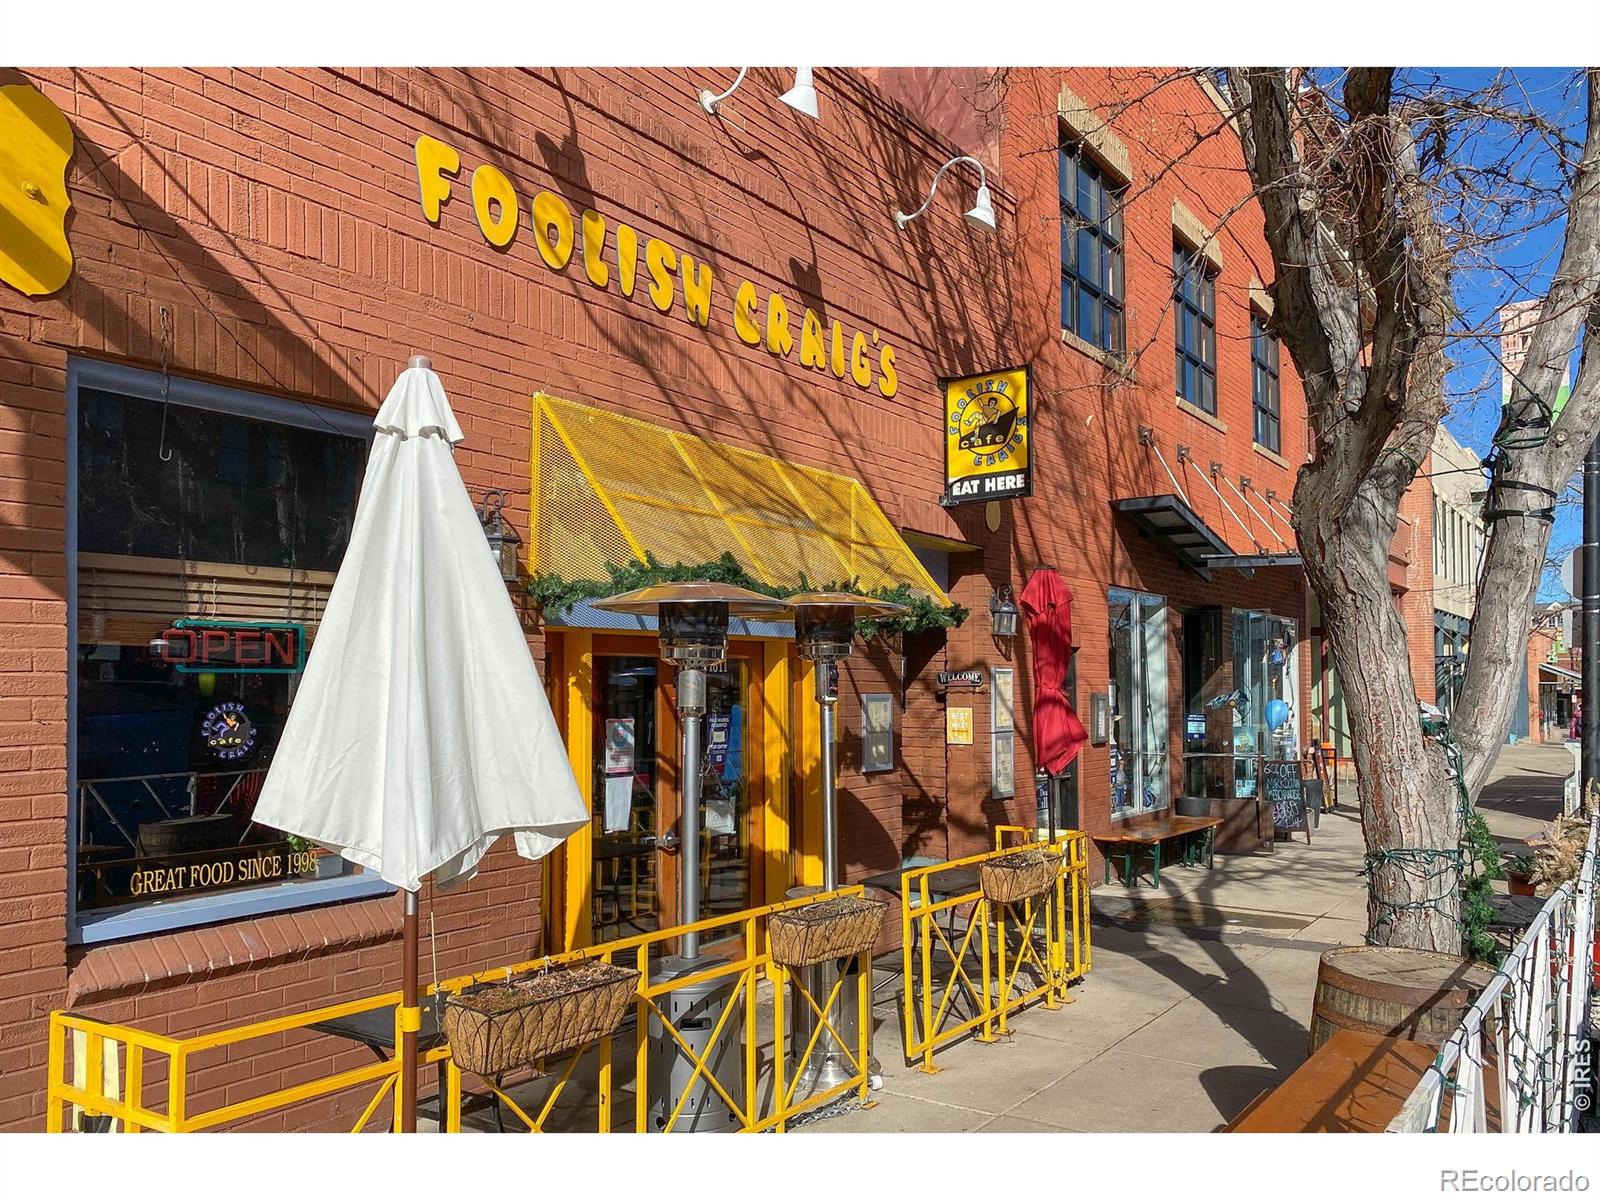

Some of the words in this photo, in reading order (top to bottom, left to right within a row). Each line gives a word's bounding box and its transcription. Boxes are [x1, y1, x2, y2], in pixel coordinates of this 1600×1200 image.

[414, 134, 713, 328] FOOLISH
[733, 280, 898, 398] CRAIG'S
[950, 379, 1008, 435] FOOLISH
[960, 434, 1004, 448] cafe
[952, 480, 980, 496] EAT
[984, 474, 1025, 492] HERE
[161, 628, 294, 665] OPEN
[940, 672, 981, 683] WELCOME
[209, 736, 242, 746] cafe
[1279, 763, 1298, 778] OFF
[130, 866, 187, 895] GREAT
[190, 861, 234, 888] FOOD
[238, 855, 282, 881] SINCE
[286, 850, 317, 875] 1998
